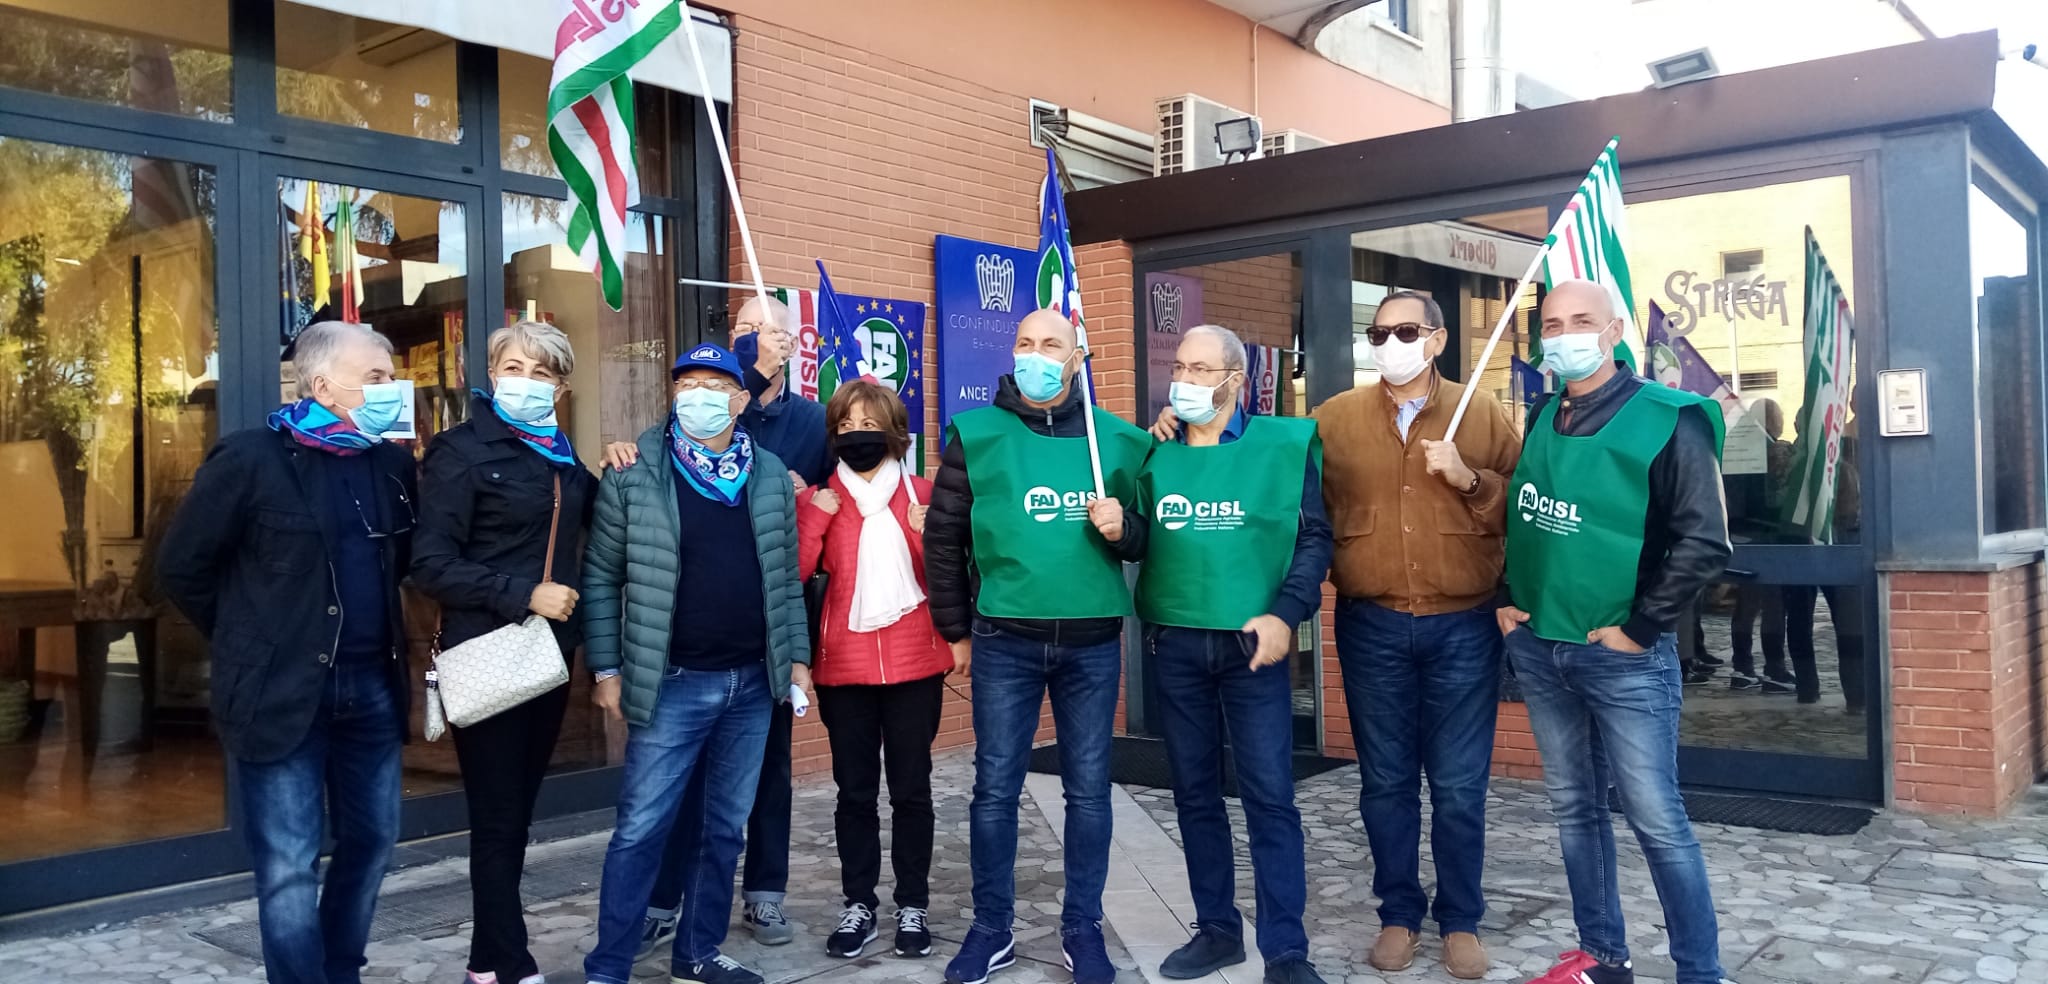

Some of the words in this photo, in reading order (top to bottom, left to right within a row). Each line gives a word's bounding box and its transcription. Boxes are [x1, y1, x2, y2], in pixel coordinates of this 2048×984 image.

[959, 387, 988, 401] ANCE
[1030, 495, 1055, 507] FAI
[1162, 502, 1187, 516] FAI
[1195, 500, 1246, 517] CISL
[1522, 489, 1536, 508] FAI
[1539, 496, 1582, 522] CISL
